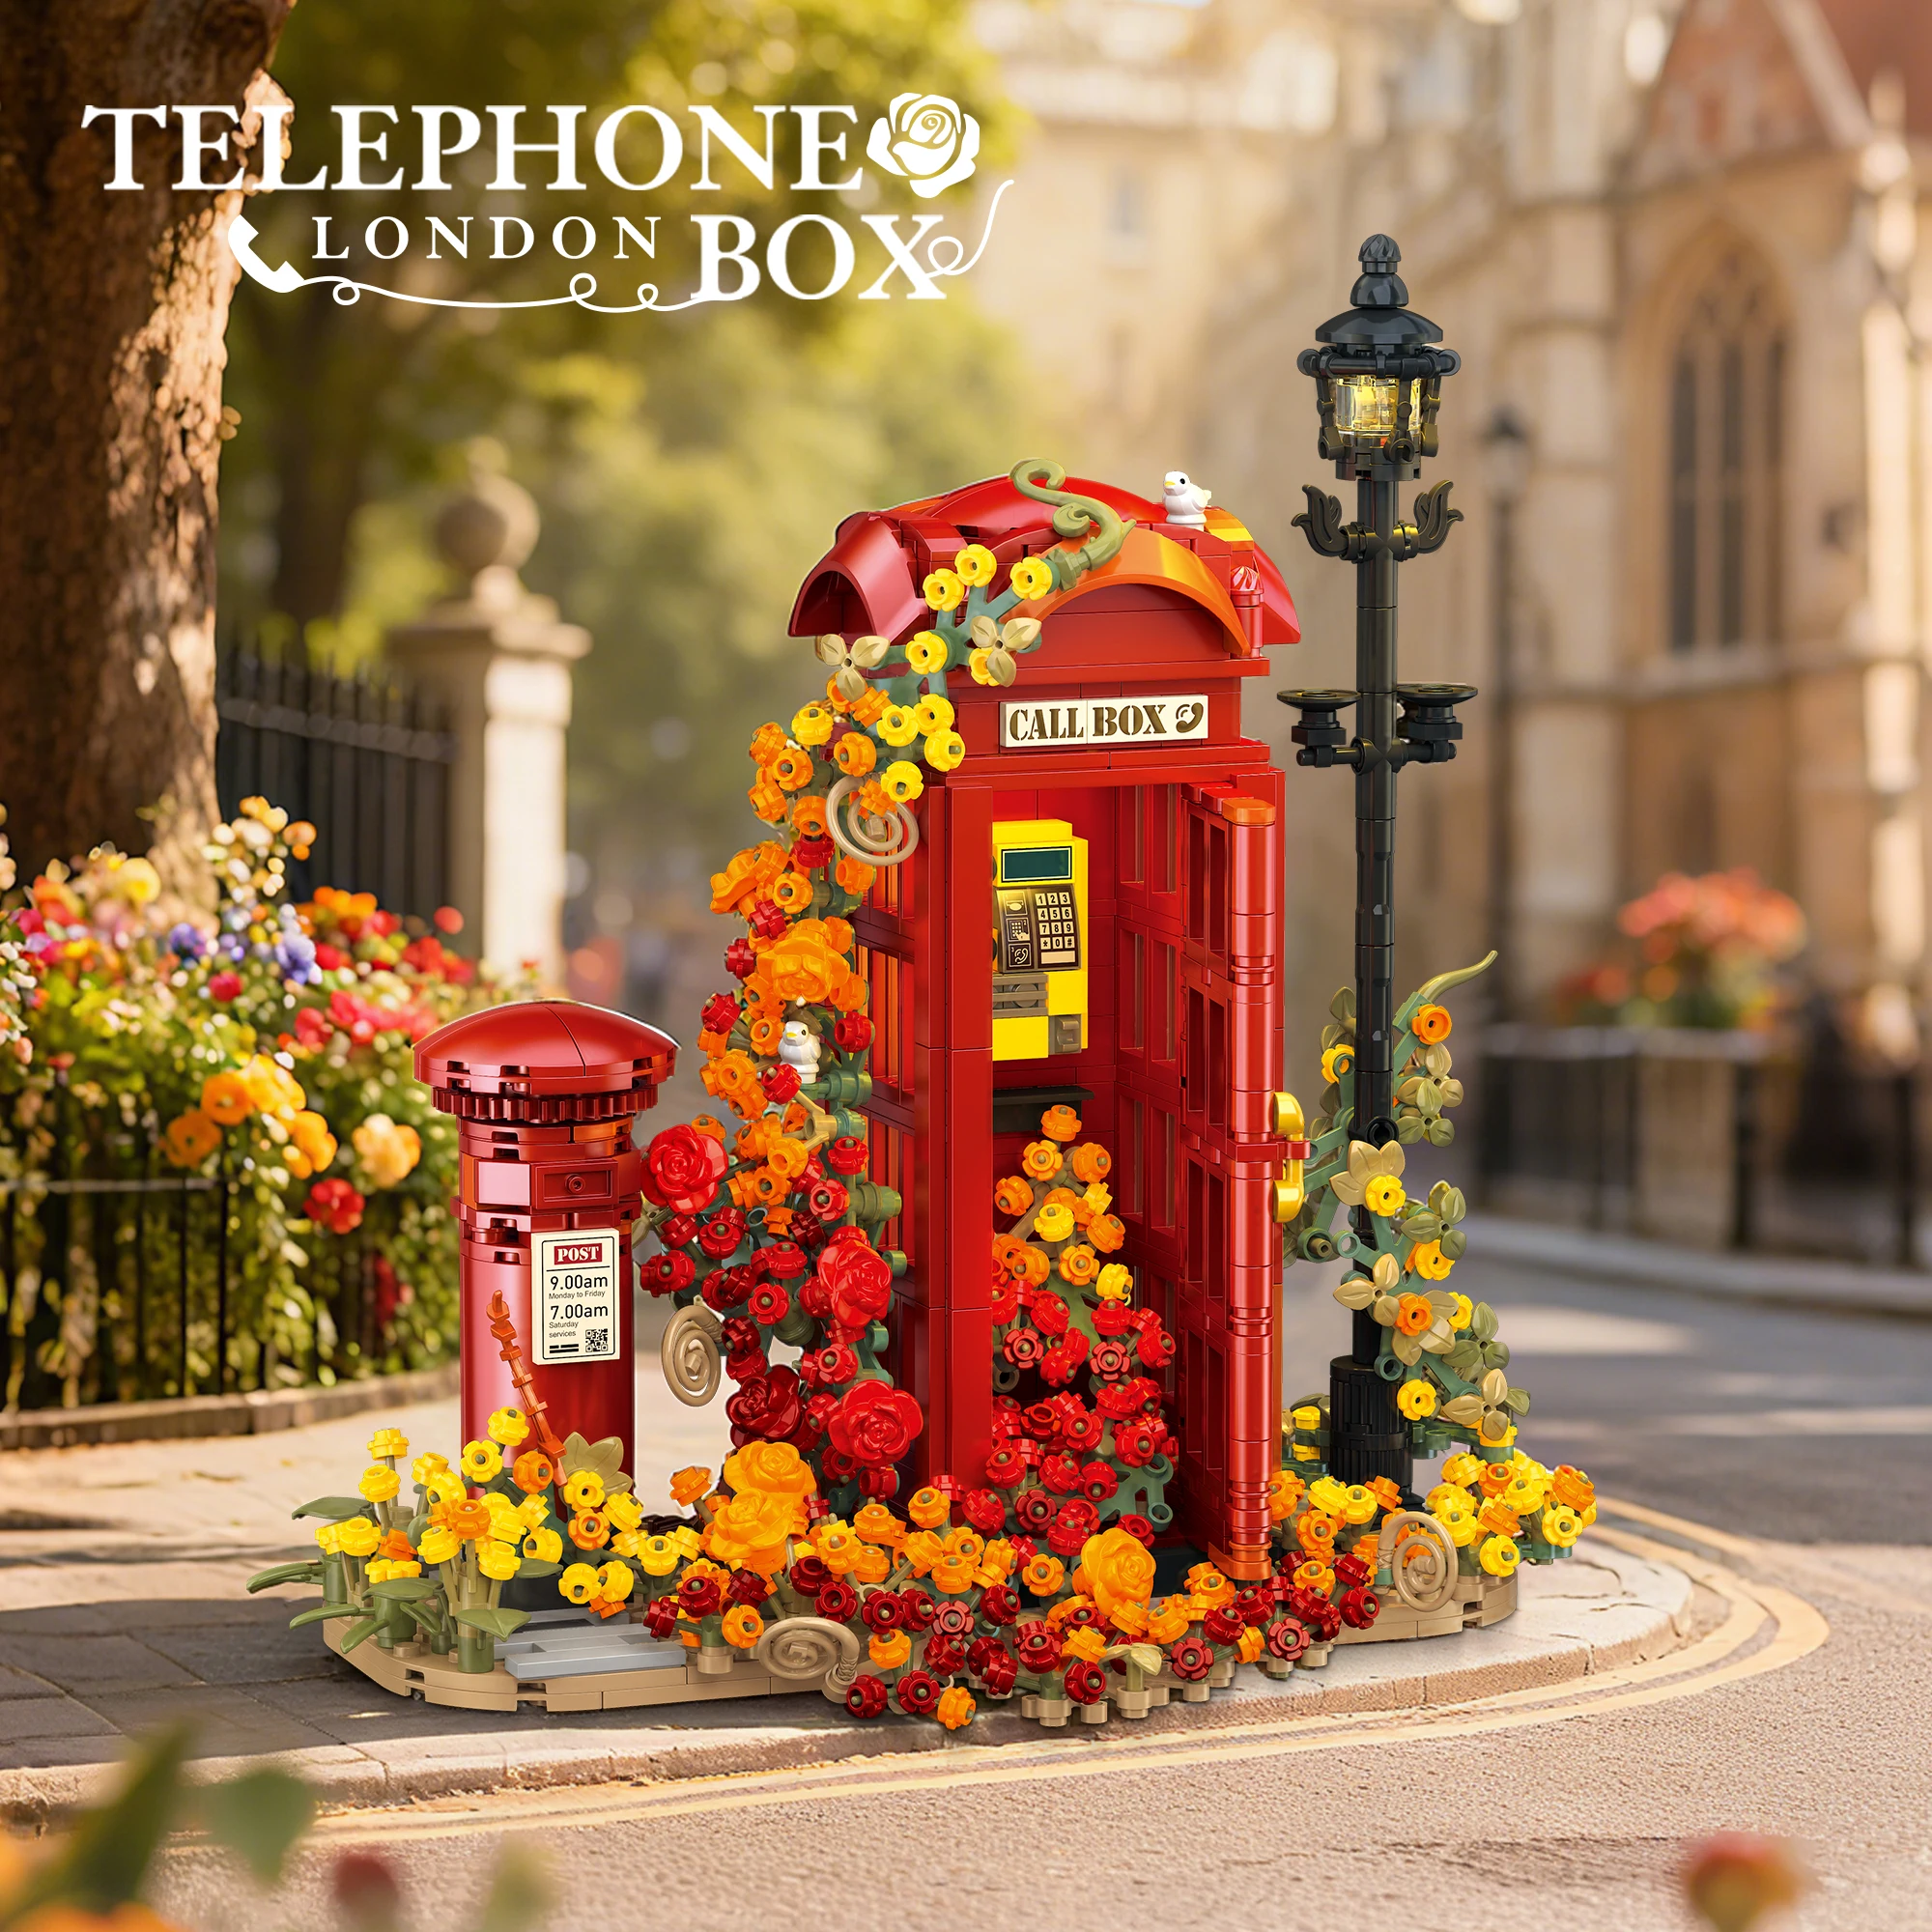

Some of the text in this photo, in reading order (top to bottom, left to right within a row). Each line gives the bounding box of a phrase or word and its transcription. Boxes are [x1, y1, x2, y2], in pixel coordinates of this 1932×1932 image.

[1009, 704, 1167, 741] CALL BOX
[1050, 895, 1055, 904] 2
[1063, 894, 1068, 903] 3
[1065, 909, 1070, 918] 6
[1041, 923, 1071, 933] 7 8 9
[557, 1246, 599, 1263] POST
[550, 1275, 609, 1291] 9.00am
[550, 1304, 609, 1320] 7.00am
[549, 1321, 579, 1329] Saturday
